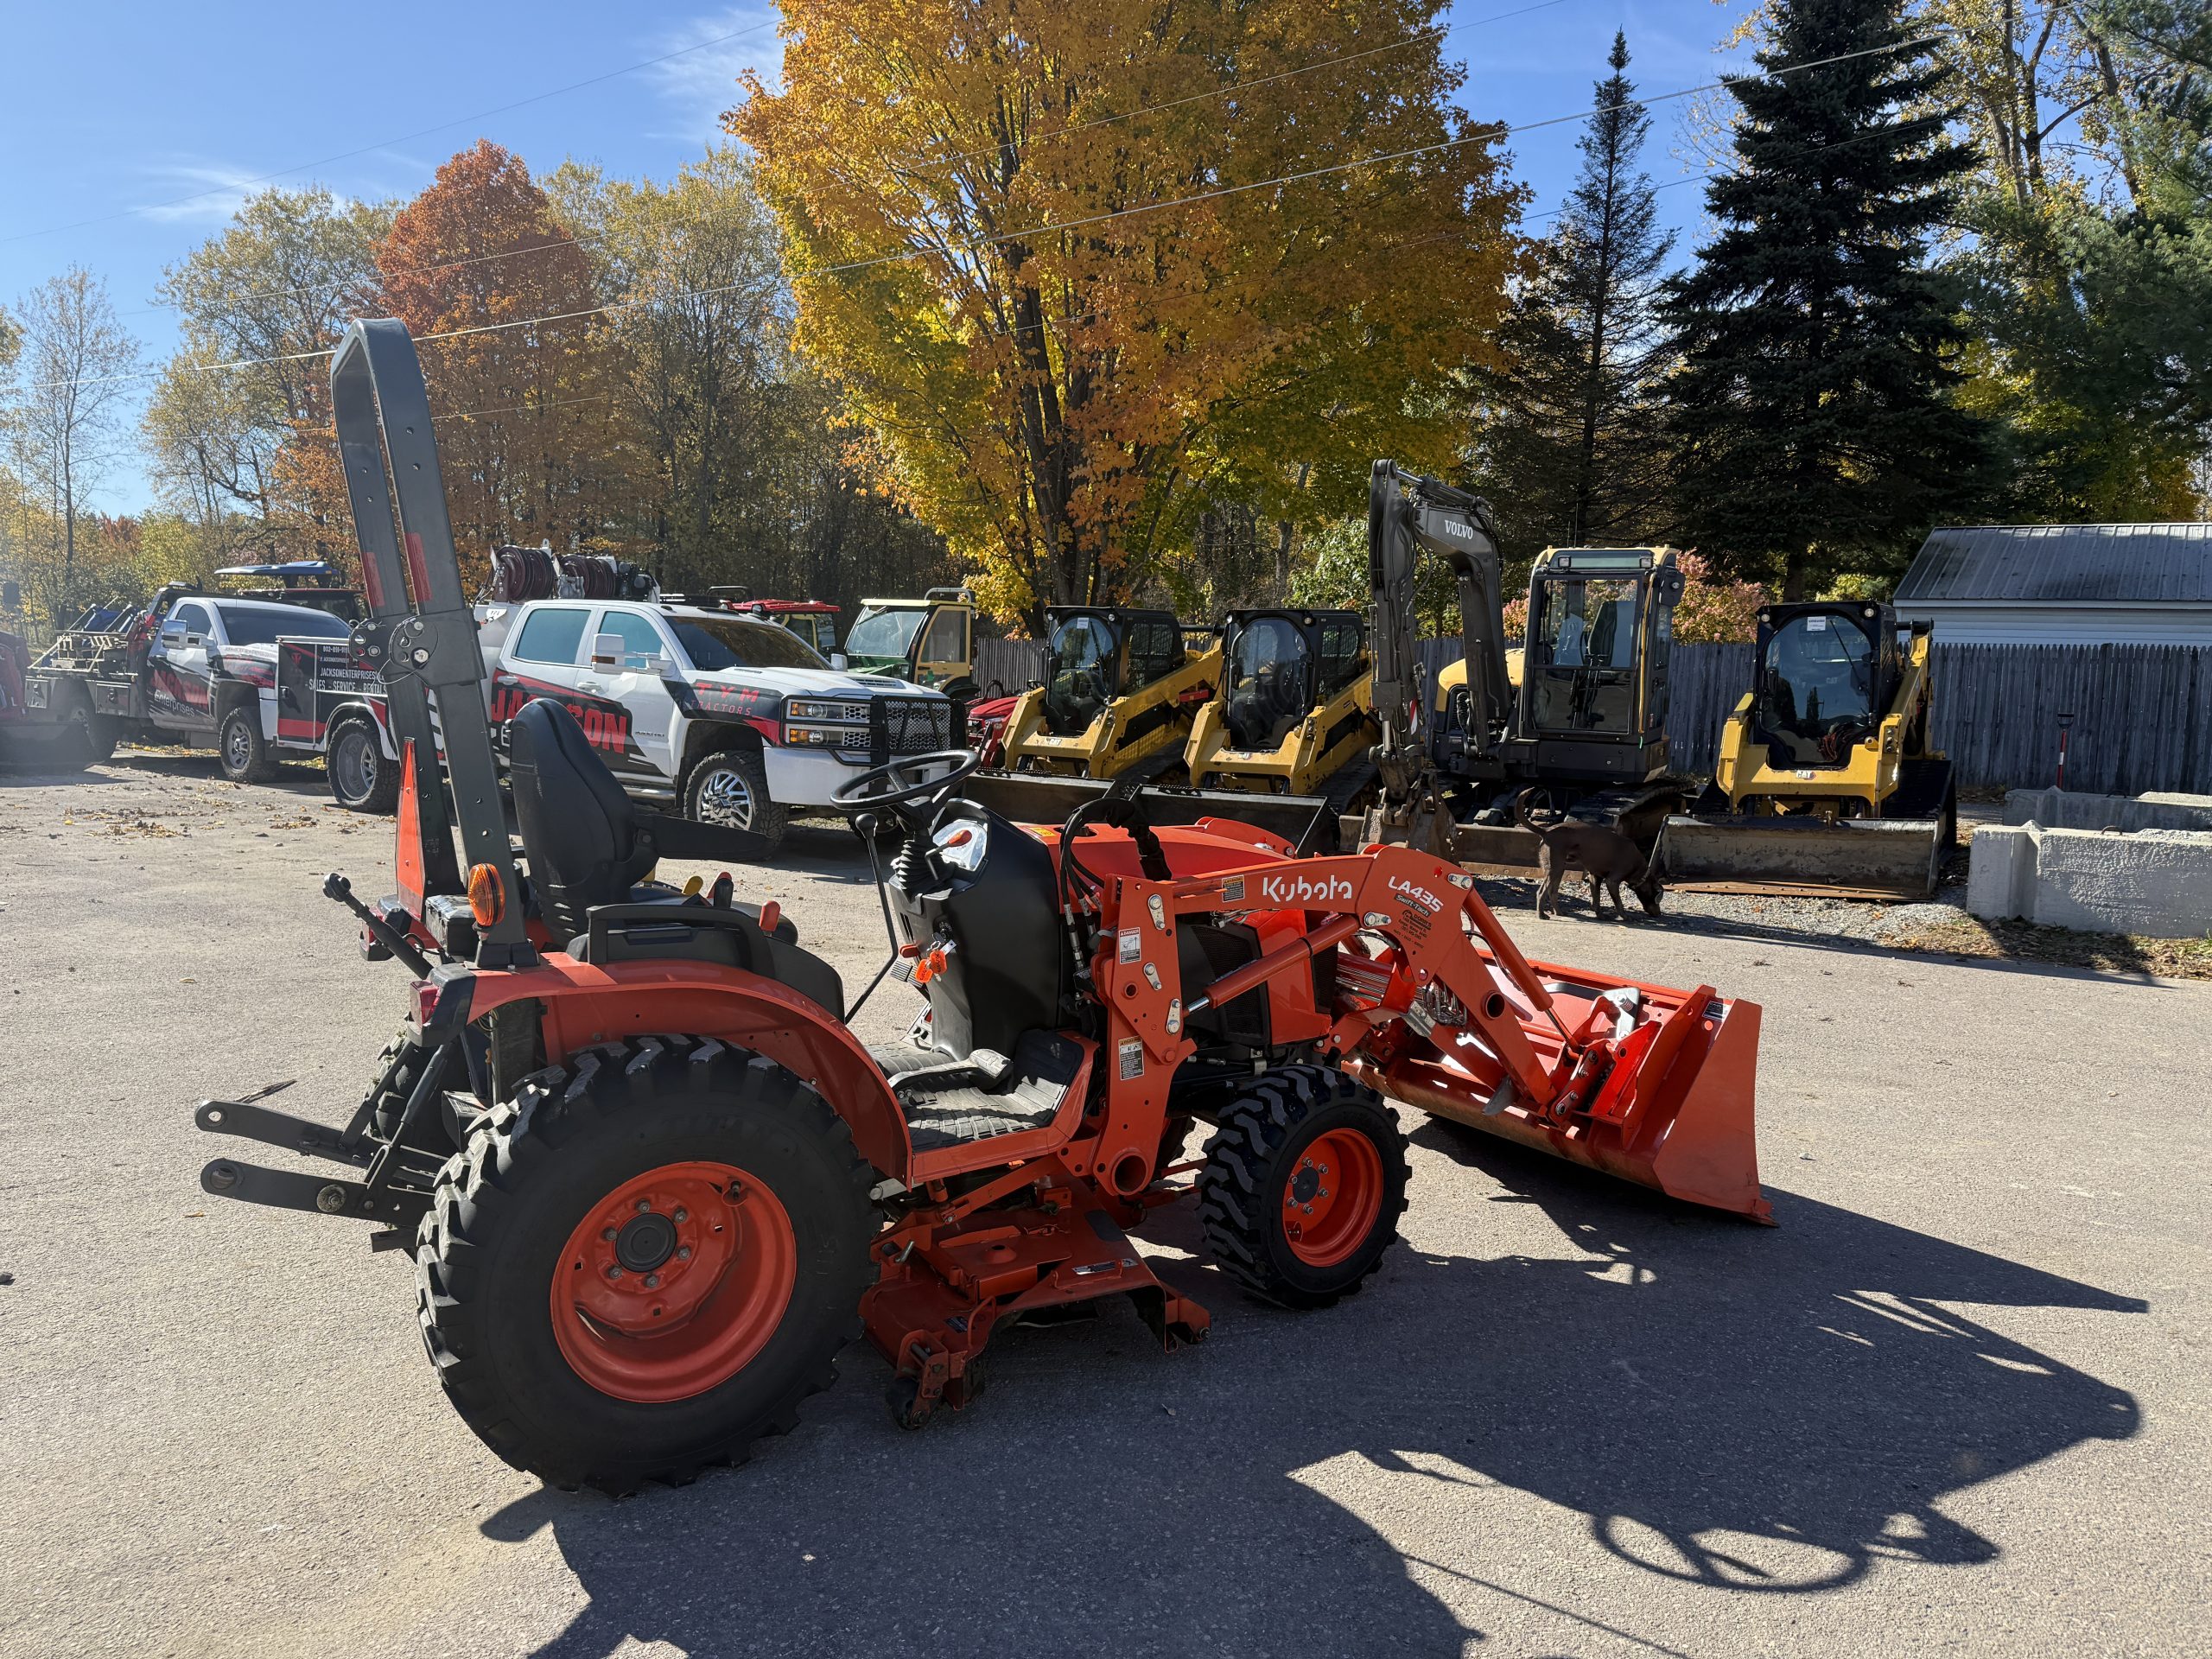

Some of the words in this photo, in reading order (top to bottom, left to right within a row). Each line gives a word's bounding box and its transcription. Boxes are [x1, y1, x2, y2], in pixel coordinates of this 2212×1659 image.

[1444, 519, 1474, 540] VOLVO
[308, 678, 326, 690] SALES
[333, 679, 356, 693] SERVICE
[363, 682, 388, 696] RENTALS
[695, 682, 760, 702] TYM
[154, 689, 195, 717] Enterprises
[690, 701, 752, 716] TRACTORS
[491, 688, 627, 754] JASON
[1262, 874, 1352, 903] Kubota
[1388, 875, 1444, 912] LA435
[1395, 893, 1431, 918] Swift-Tach
